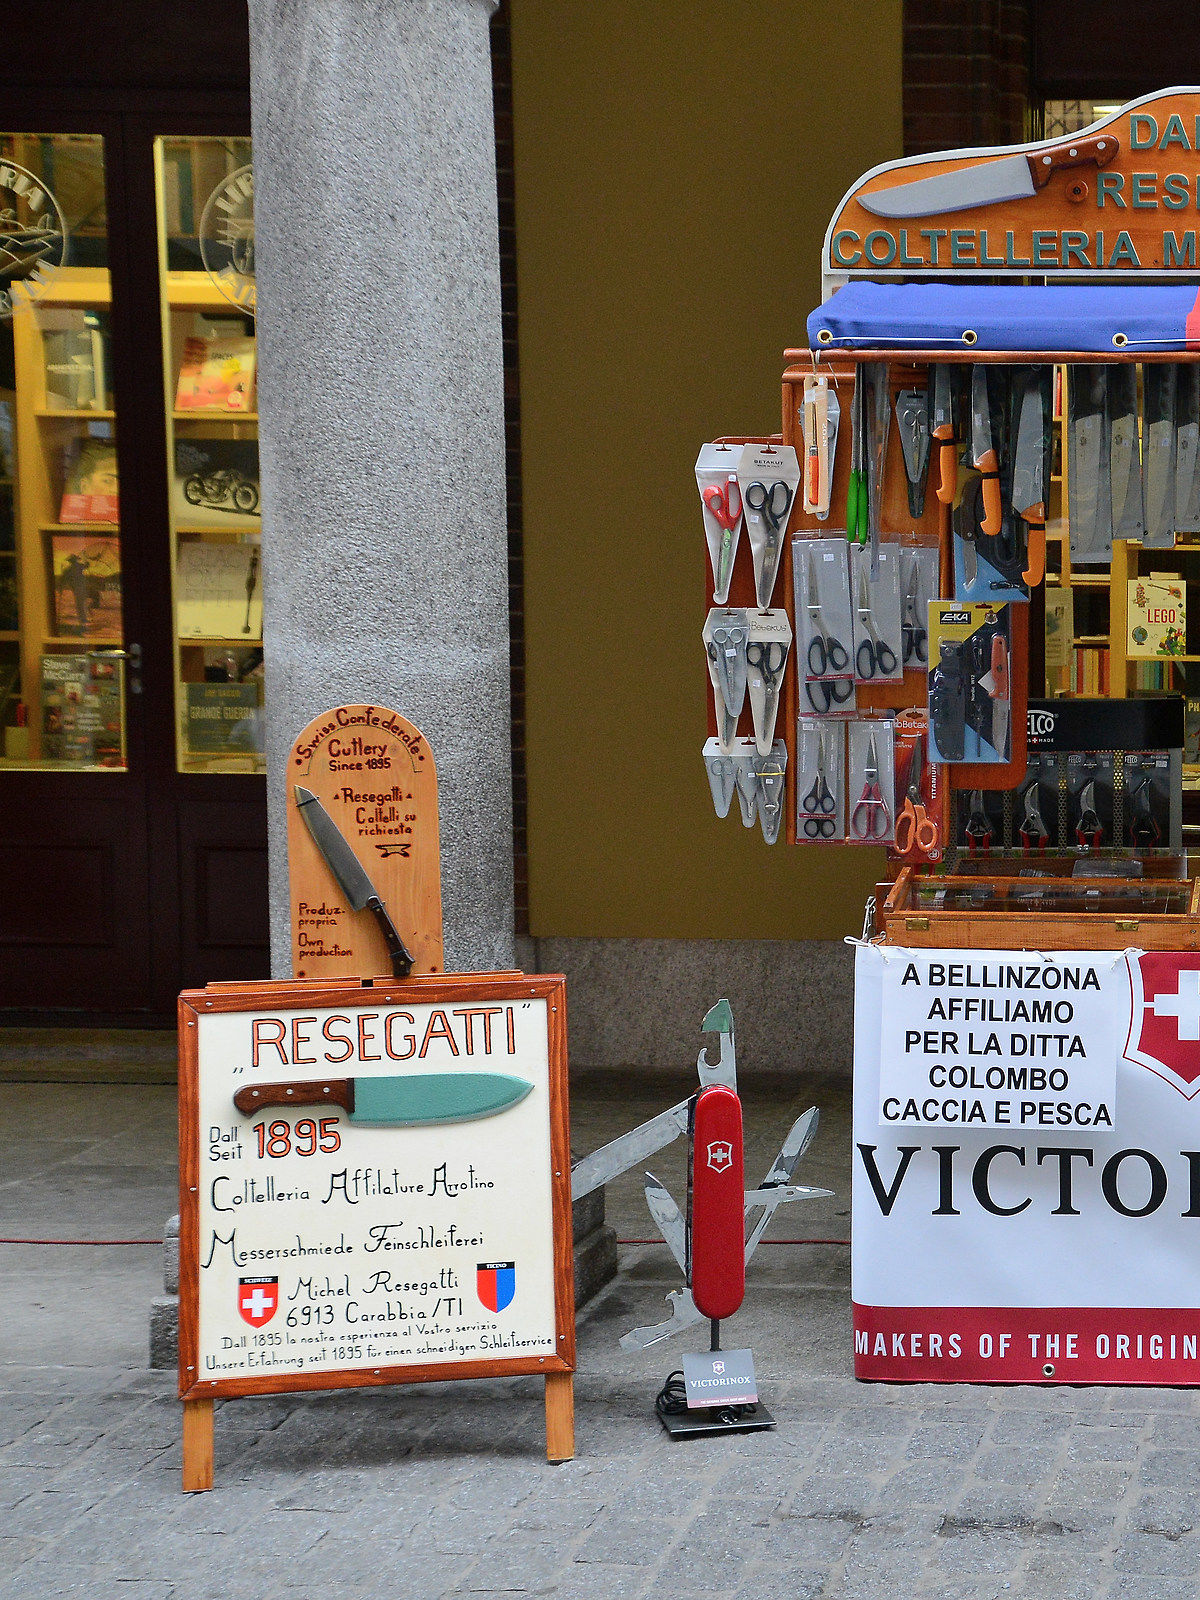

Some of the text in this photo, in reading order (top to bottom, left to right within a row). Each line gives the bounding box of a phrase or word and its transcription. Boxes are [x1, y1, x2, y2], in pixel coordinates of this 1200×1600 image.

[833, 229, 1141, 268] COLTELLERIA
[941, 613, 968, 621] EKA
[1147, 608, 1176, 623] LEGO
[296, 706, 423, 760] Swiss Confederate
[327, 737, 388, 758] Cutlery
[328, 758, 392, 772] Since 1895
[341, 786, 404, 806] Resegatti
[355, 807, 416, 825] Coltelli su
[358, 822, 413, 836] richiesta
[298, 918, 337, 932] propria
[298, 932, 323, 947] Own
[298, 944, 353, 963] production
[901, 963, 1101, 991] A BELLINZONA
[927, 998, 1074, 1024] AFFILIAMO
[905, 1030, 1086, 1058] PER LA DITTA
[928, 1064, 1069, 1092] COLOMBO
[882, 1097, 1112, 1126] CACCIA E PESCA
[253, 1117, 341, 1159] 1895
[209, 1143, 242, 1161] Seit
[211, 1162, 495, 1213] Coltelleria Affilature Arrotino
[200, 1221, 484, 1268] Messerschmiede Feinschleiferei
[287, 1268, 458, 1300] Michel Resegatti
[286, 1304, 334, 1328] 6913
[345, 1301, 426, 1324] Carabbia
[252, 1333, 282, 1347] 1895
[286, 1332, 296, 1345] la
[301, 1330, 335, 1343] nostra
[340, 1328, 398, 1342] esperienza
[402, 1325, 411, 1336] al
[415, 1323, 451, 1335] Vostro
[456, 1321, 498, 1332] servizio
[855, 1329, 962, 1358] MAKERS
[979, 1333, 1012, 1358] OF
[1028, 1333, 1080, 1359] THE
[206, 1355, 244, 1370] Unsere
[247, 1351, 304, 1368] Erfahrung
[309, 1348, 326, 1362] seit
[331, 1346, 362, 1360] 1895
[385, 1346, 412, 1356] einen
[416, 1339, 476, 1355] schneidigen
[480, 1331, 552, 1350] Schleifservice
[690, 1376, 751, 1388] VICTORINOX
